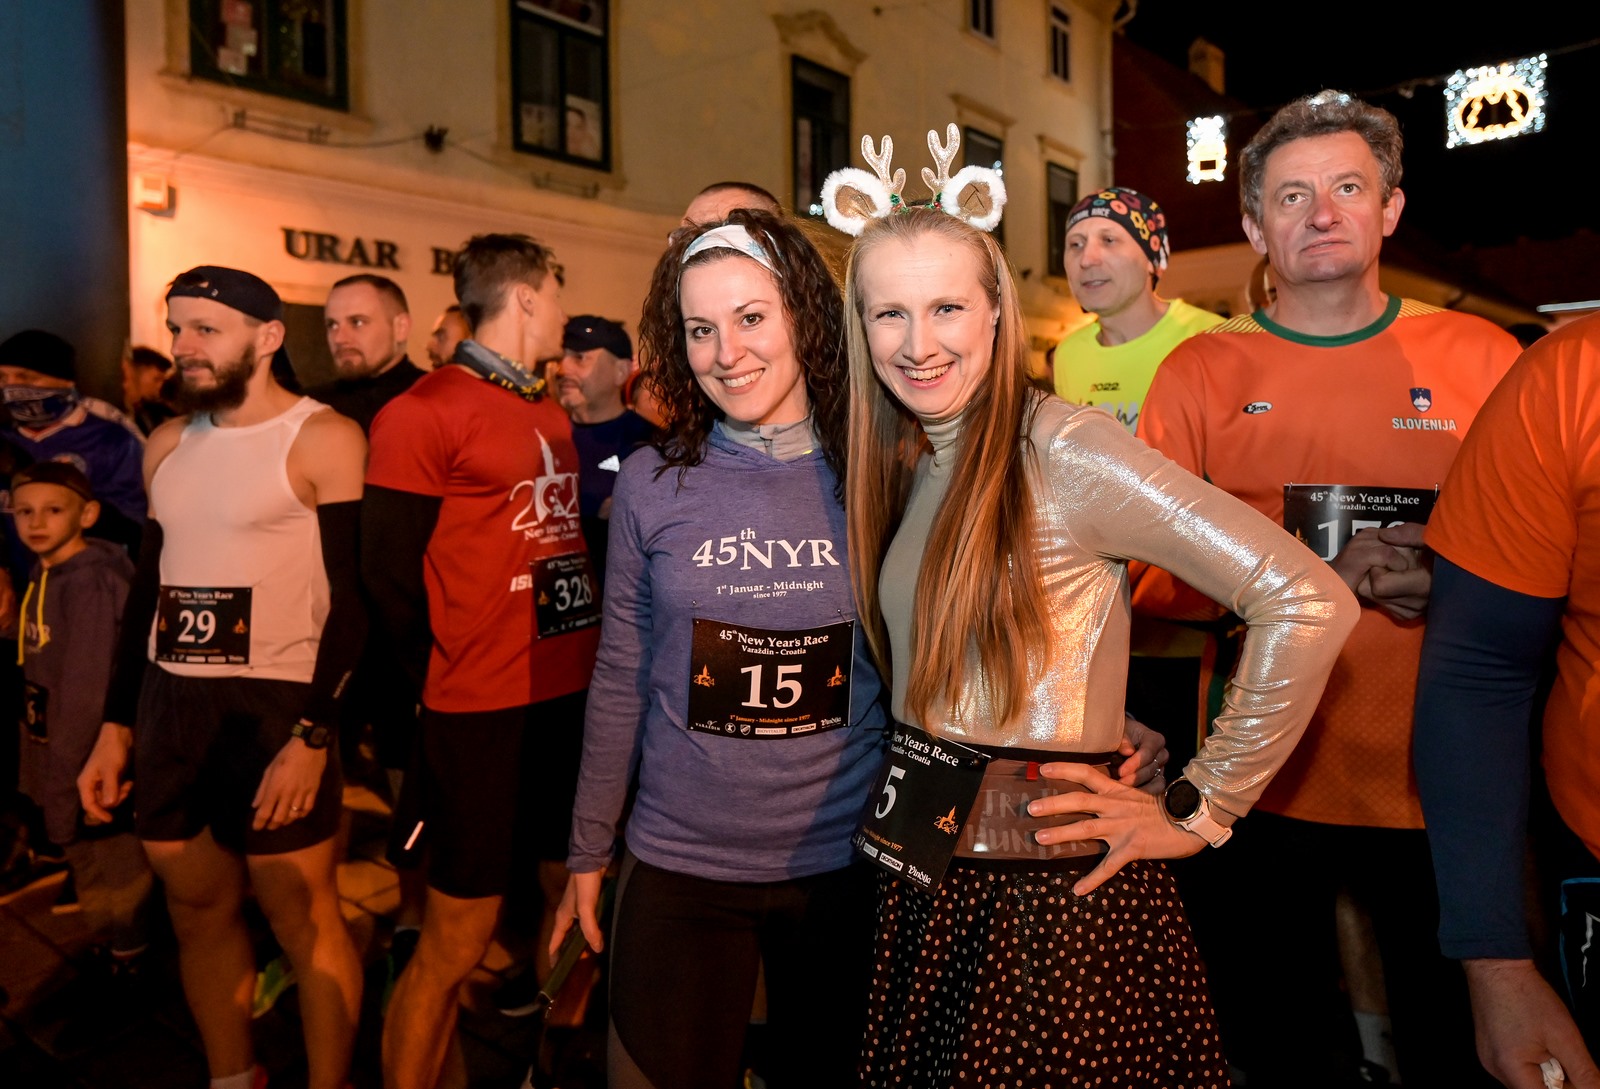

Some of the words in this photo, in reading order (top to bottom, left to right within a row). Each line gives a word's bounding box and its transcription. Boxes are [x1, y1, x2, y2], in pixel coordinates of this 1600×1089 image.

[281, 227, 402, 271] URAR
[1391, 417, 1457, 431] SLOVENIJA
[1329, 492, 1356, 503] New
[1359, 493, 1391, 504] Year's
[1394, 494, 1420, 505] Race
[1372, 504, 1398, 512] Croatia
[740, 539, 840, 571] NYR
[555, 574, 592, 612] 328
[716, 584, 727, 594] 1st
[730, 584, 764, 595] Januar
[773, 580, 824, 591] Midnight
[753, 591, 771, 599] since
[178, 609, 217, 644] 29
[719, 629, 738, 641] 45th
[738, 633, 764, 646] New
[767, 637, 801, 648] Year's
[803, 634, 829, 646] Race
[741, 645, 774, 655] Varaždin
[780, 648, 806, 656] Croatia
[740, 664, 803, 709] 15
[904, 734, 930, 754] Year's
[931, 745, 960, 767] Race
[908, 750, 931, 766] Croatia
[874, 765, 906, 819] 5
[890, 842, 903, 852] 1977
